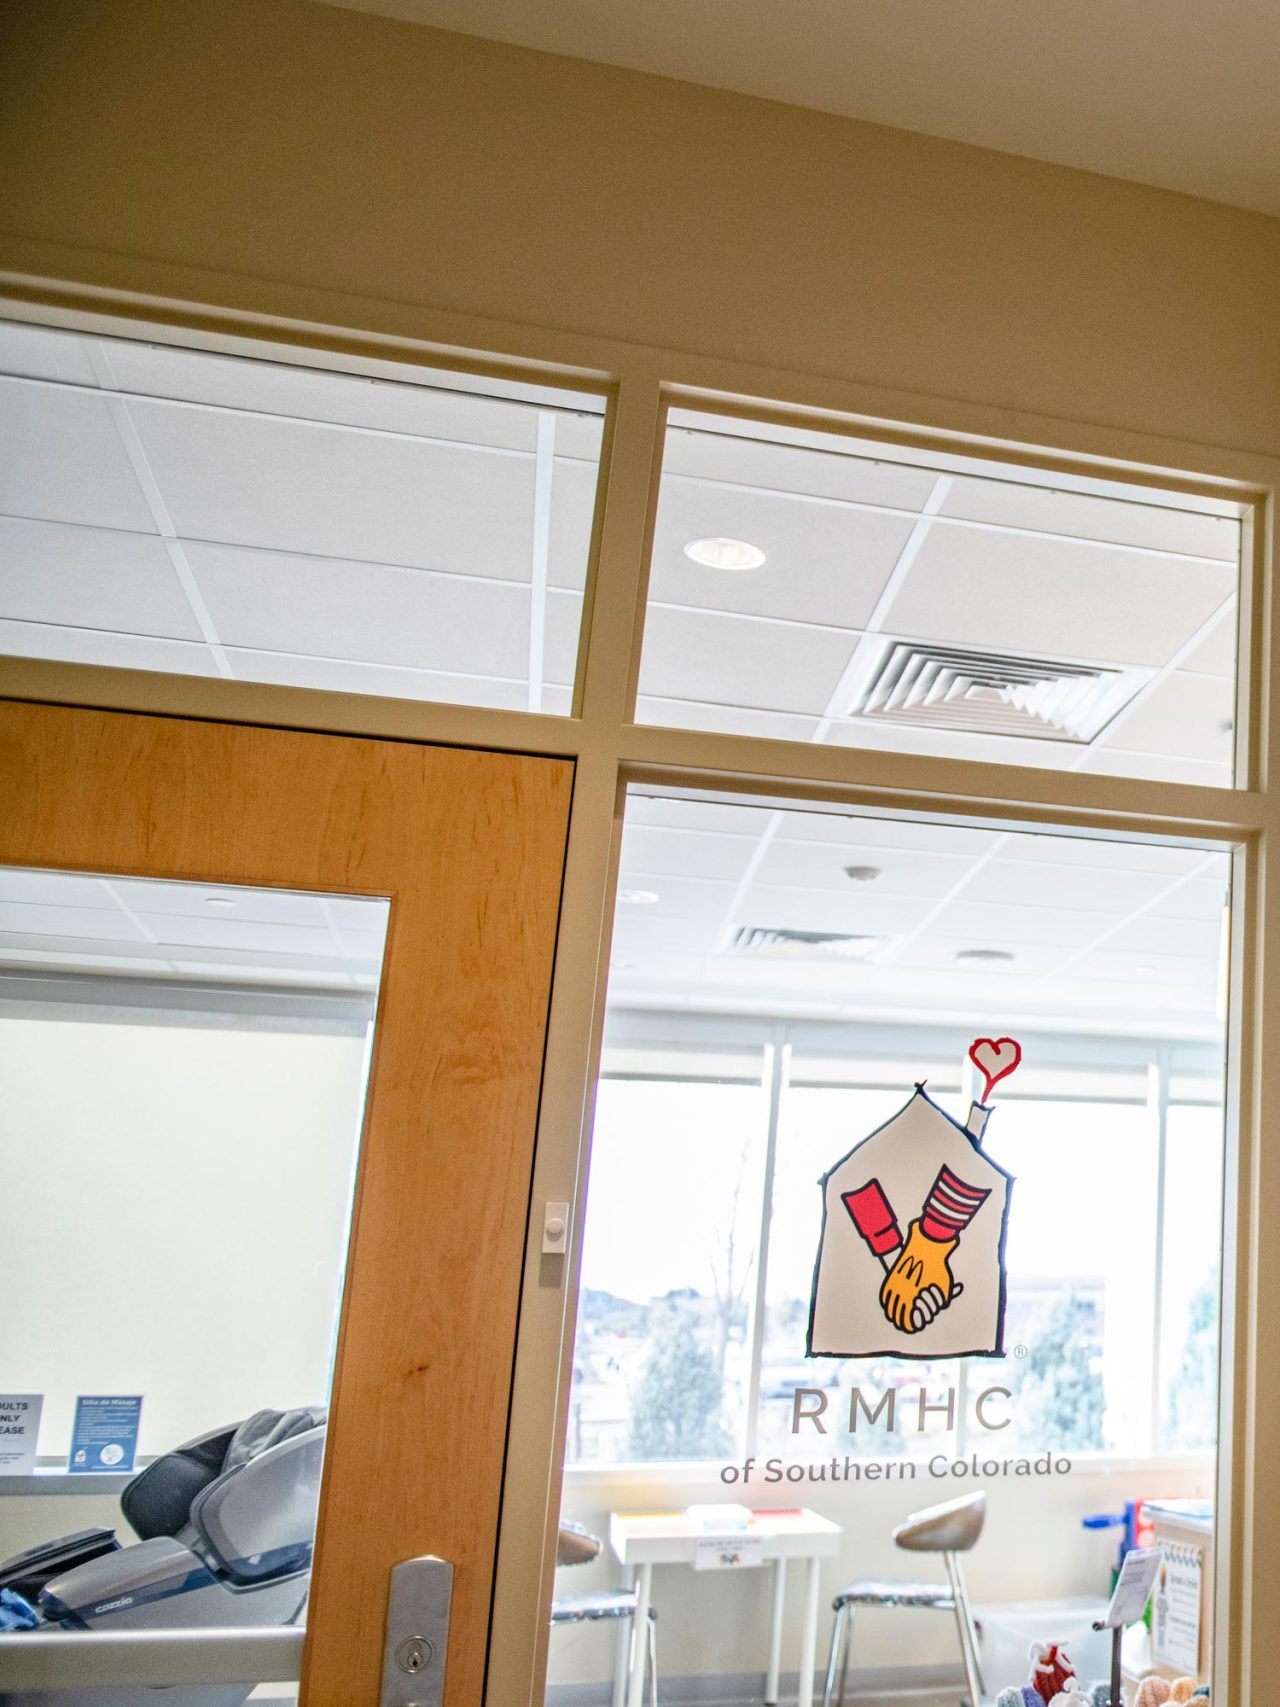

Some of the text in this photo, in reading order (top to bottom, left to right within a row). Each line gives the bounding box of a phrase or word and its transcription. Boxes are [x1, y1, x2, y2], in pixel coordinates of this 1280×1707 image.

[0, 1414, 21, 1423] NLY
[791, 1386, 1014, 1435] RMHC
[720, 1451, 1072, 1484] of Southern Colorado
